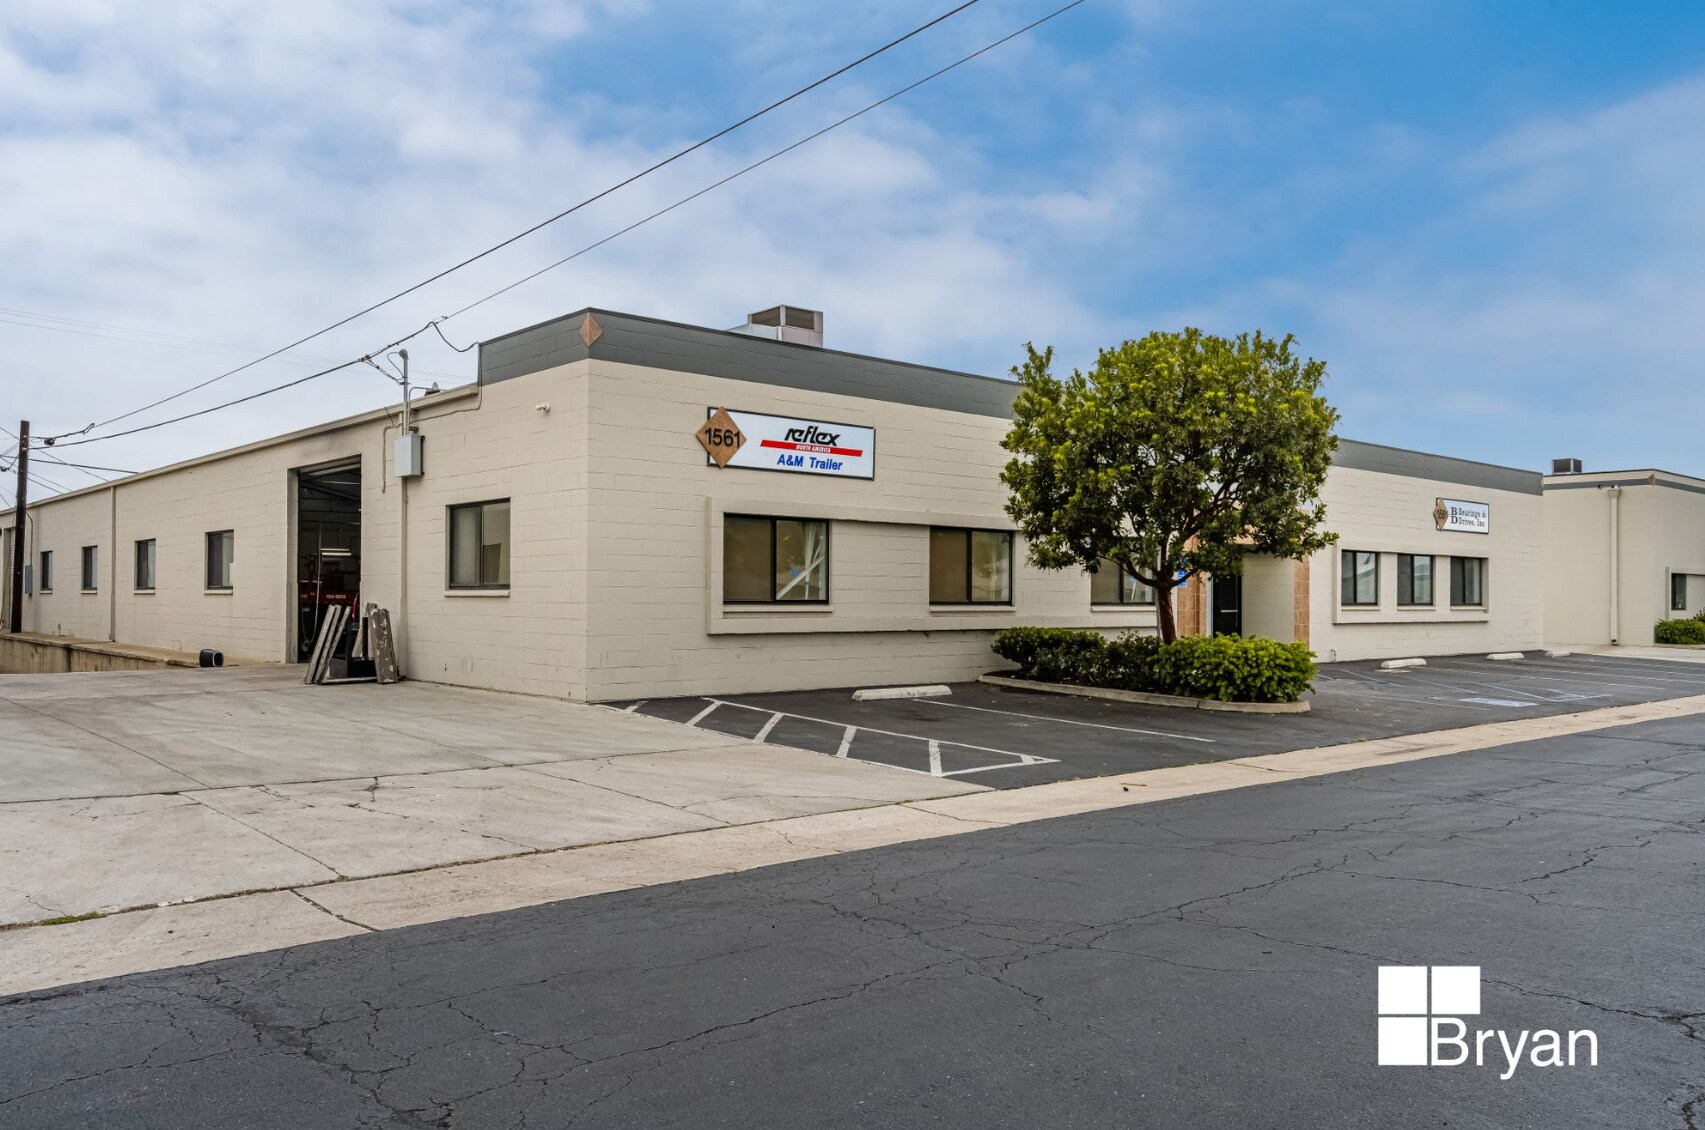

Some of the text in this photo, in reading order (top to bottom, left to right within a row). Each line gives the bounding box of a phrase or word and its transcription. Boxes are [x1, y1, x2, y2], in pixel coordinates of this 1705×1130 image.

[705, 427, 740, 448] 1561
[784, 426, 840, 446] reflex
[777, 453, 843, 470] A&M Trailer
[1459, 508, 1481, 519] Bearings
